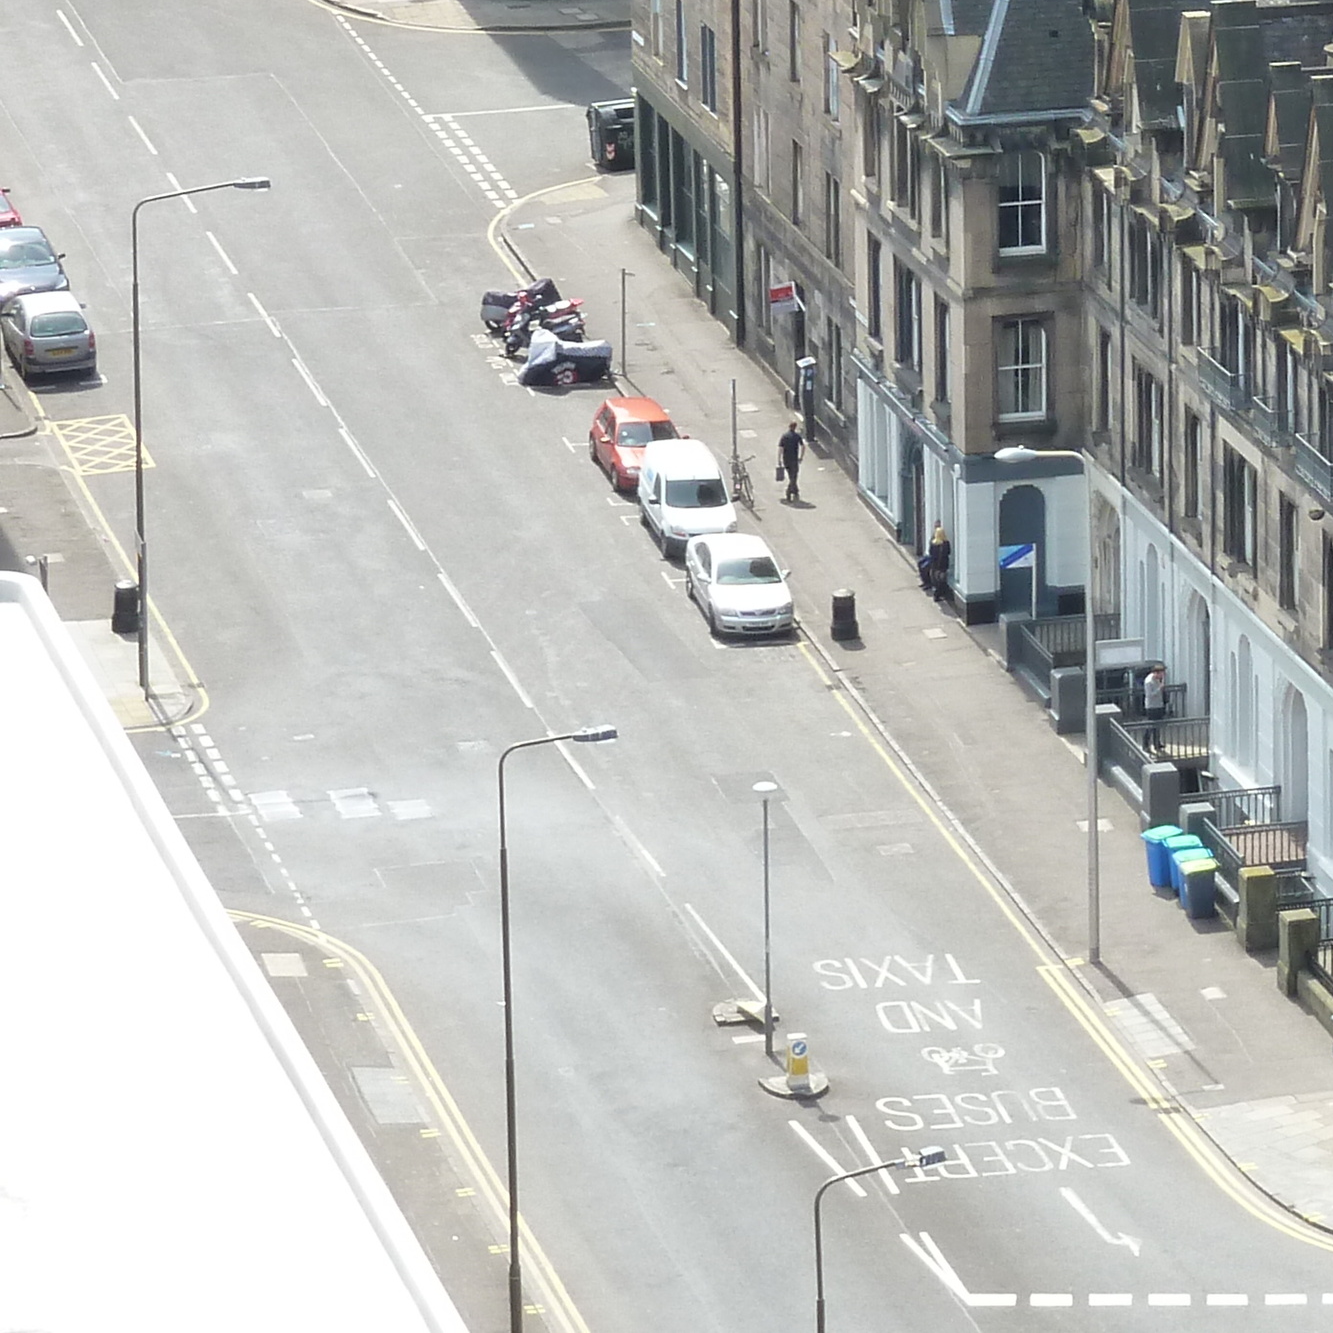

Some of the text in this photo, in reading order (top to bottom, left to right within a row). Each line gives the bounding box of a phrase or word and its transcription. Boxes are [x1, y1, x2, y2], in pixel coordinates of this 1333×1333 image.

[812, 953, 981, 991] TAXIS
[876, 998, 983, 1034] AND
[875, 1086, 1078, 1132] BUSES
[900, 1133, 1131, 1183] EXCEPT
